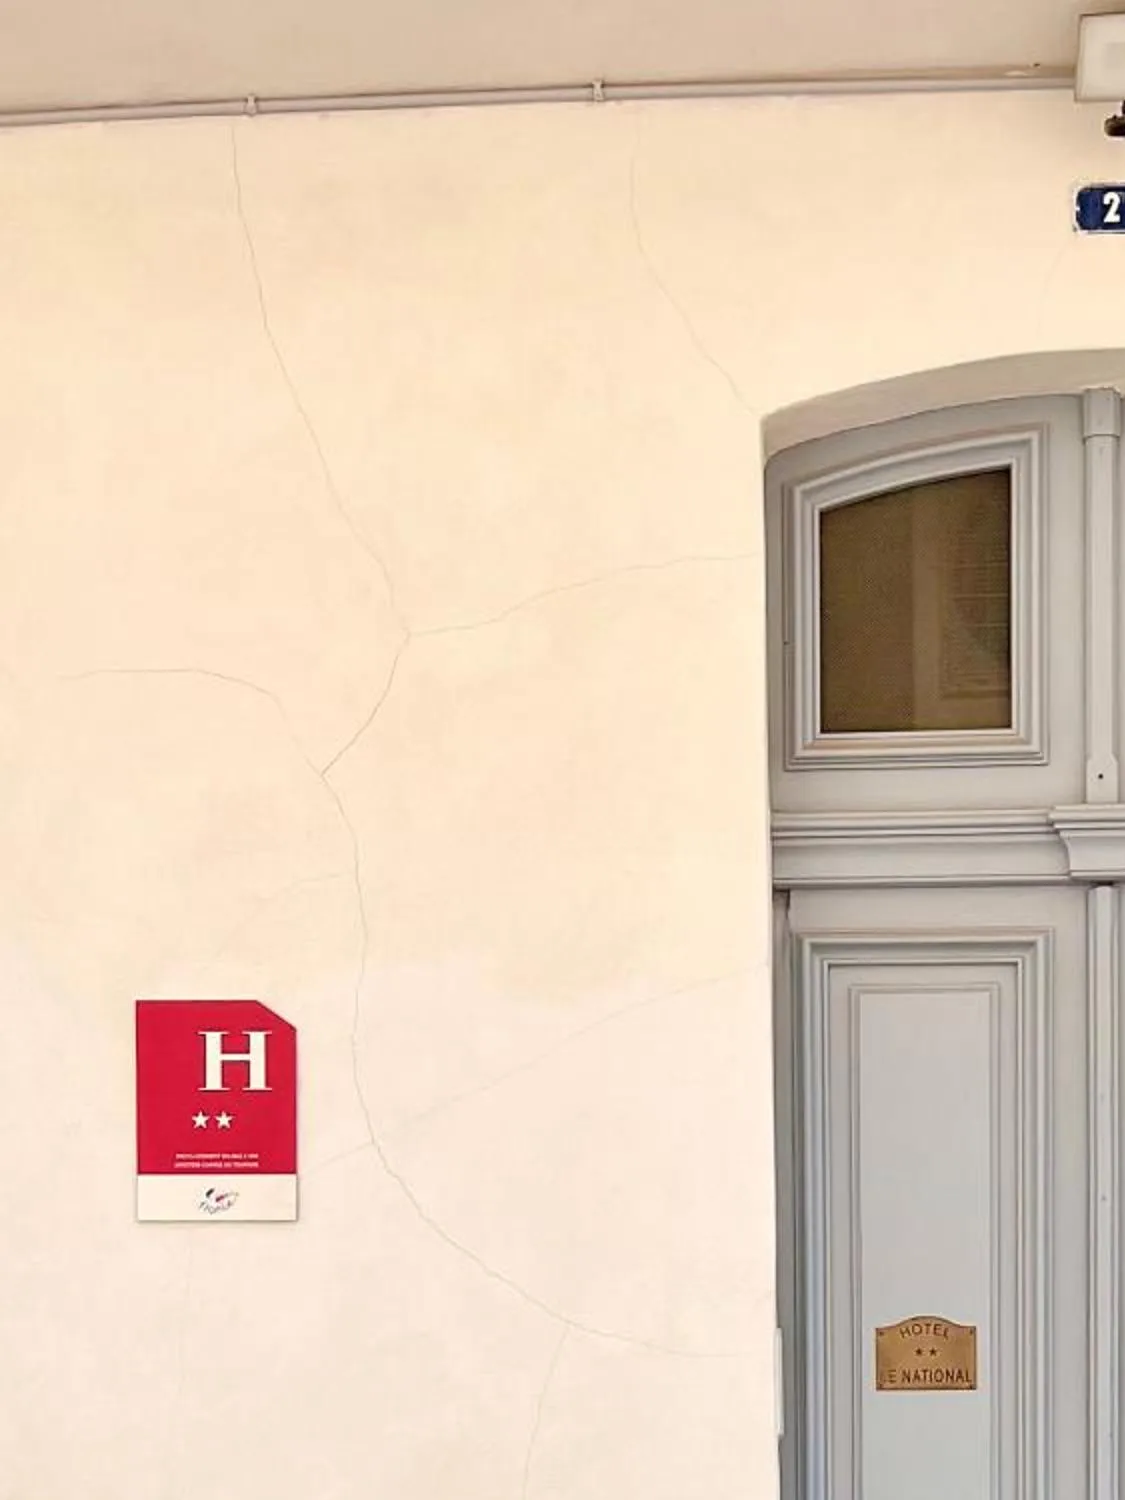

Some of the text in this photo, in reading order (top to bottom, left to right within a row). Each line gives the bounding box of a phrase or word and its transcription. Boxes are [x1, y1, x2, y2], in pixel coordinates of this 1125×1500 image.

[1103, 191, 1121, 223] 2
[197, 1030, 273, 1092] H
[900, 1323, 949, 1340] HOTEL
[901, 1367, 972, 1383] NATIONAL
